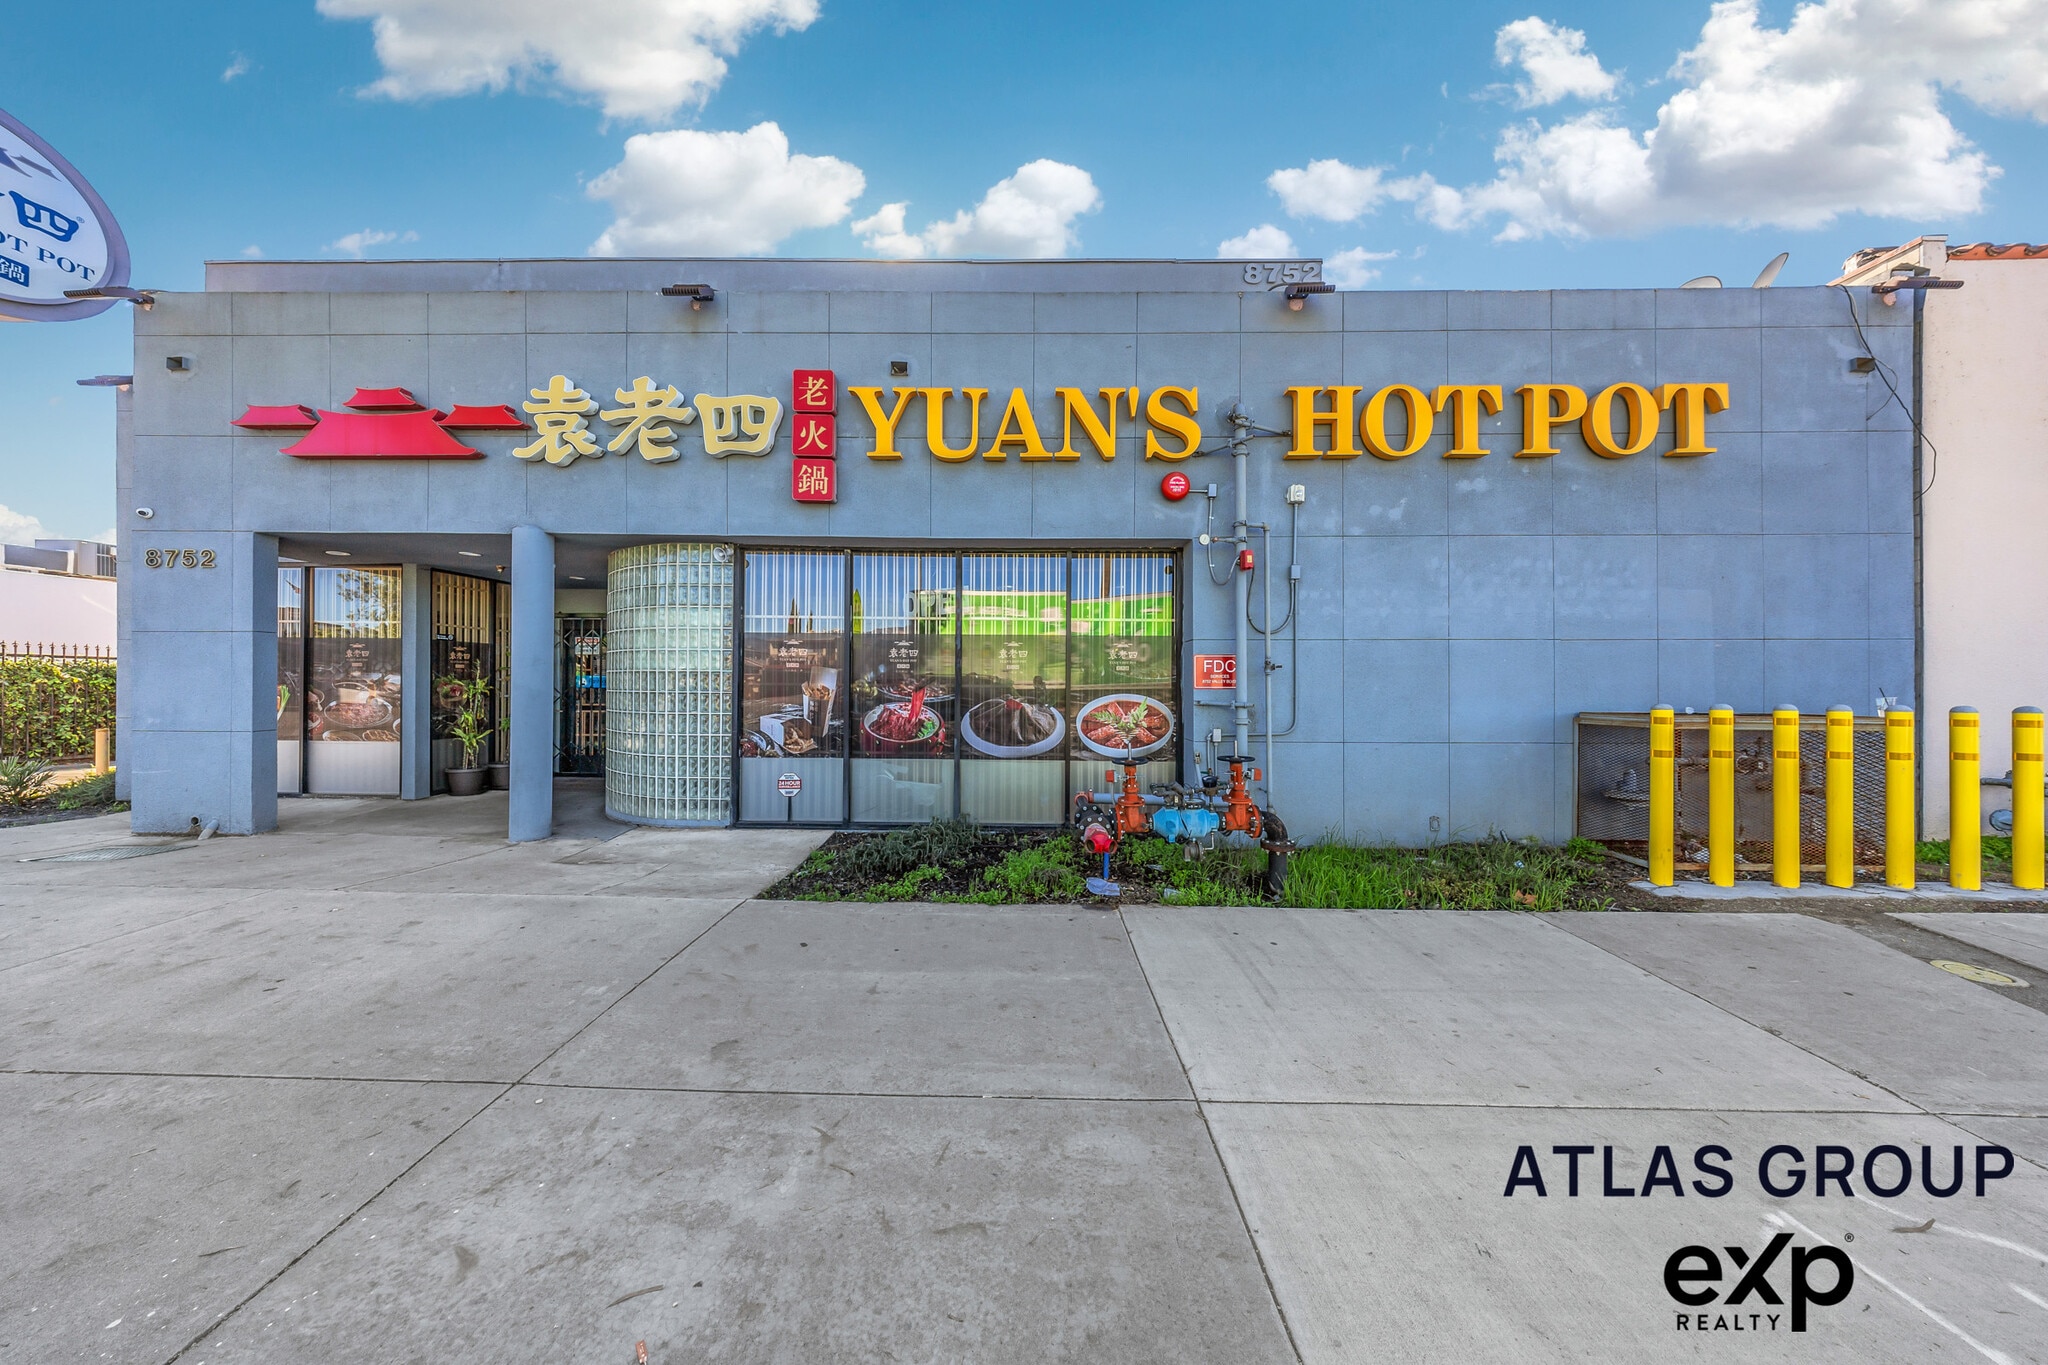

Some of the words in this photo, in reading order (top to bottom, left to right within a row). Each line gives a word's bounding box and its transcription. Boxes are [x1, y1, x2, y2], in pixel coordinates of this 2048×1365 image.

[0, 190, 79, 242] 四
[37, 245, 96, 282] POT
[1243, 262, 1321, 285] 8752
[512, 375, 784, 467] 袁老四
[797, 375, 829, 496] 老火鍋
[847, 385, 1202, 463] YUAN'S
[1283, 383, 1503, 460] HOT
[1514, 381, 1730, 459] POT
[144, 548, 217, 568] 8752
[889, 647, 919, 658] 袁老四
[1203, 660, 1236, 673] FDC
